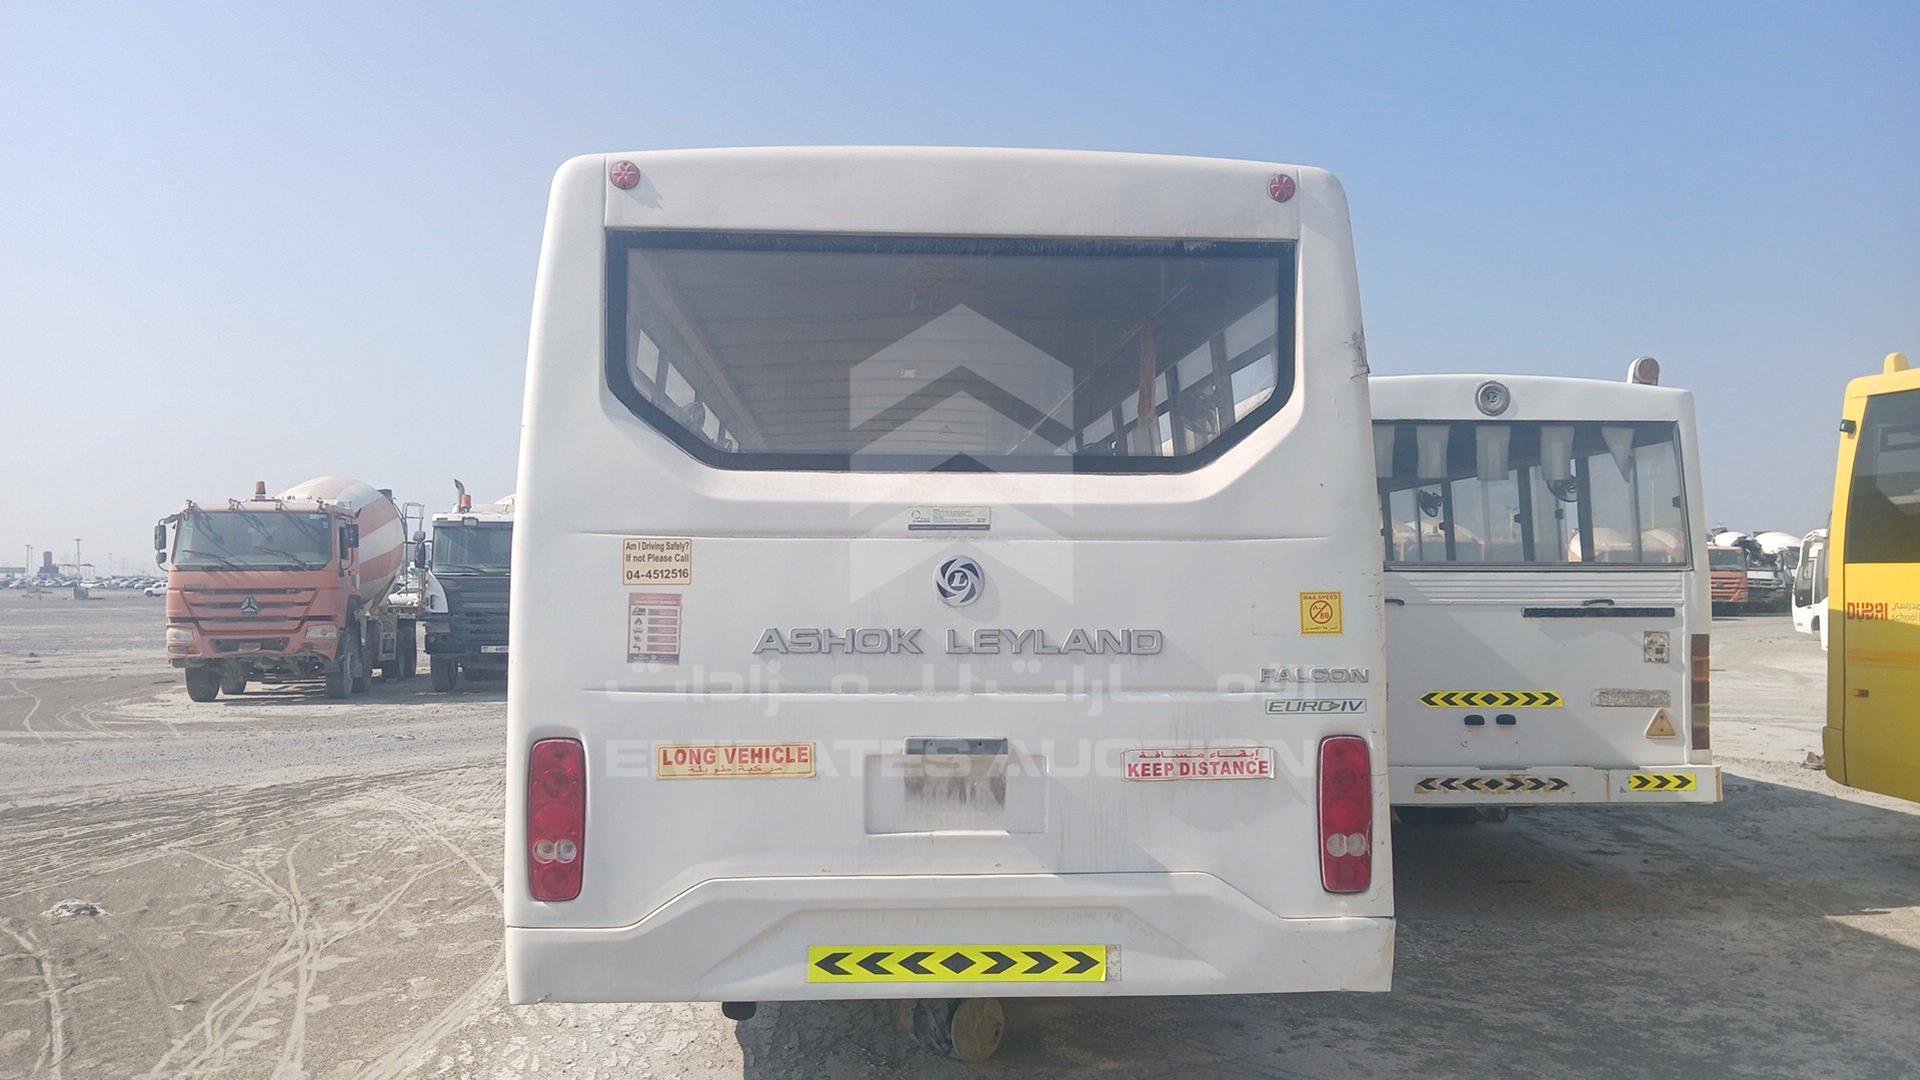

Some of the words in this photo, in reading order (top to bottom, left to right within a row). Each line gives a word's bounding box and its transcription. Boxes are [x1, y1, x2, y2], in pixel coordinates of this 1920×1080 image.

[626, 542, 637, 550] Am
[642, 542, 664, 552] Driving
[666, 541, 689, 552] Safely?
[626, 554, 631, 562] If
[633, 554, 645, 562] not
[648, 554, 672, 562] Please
[674, 554, 689, 562] Call
[626, 568, 689, 580] 04-4512516
[1847, 602, 1888, 620] DUBAI
[752, 627, 923, 655] ASHOK
[944, 627, 1163, 656] LEYLAND
[1259, 667, 1369, 683] FALCON
[662, 748, 716, 766] LONG
[724, 746, 809, 764] VEHICLE
[1127, 762, 1174, 777] KEEP
[1179, 760, 1269, 776] DISTANCE
